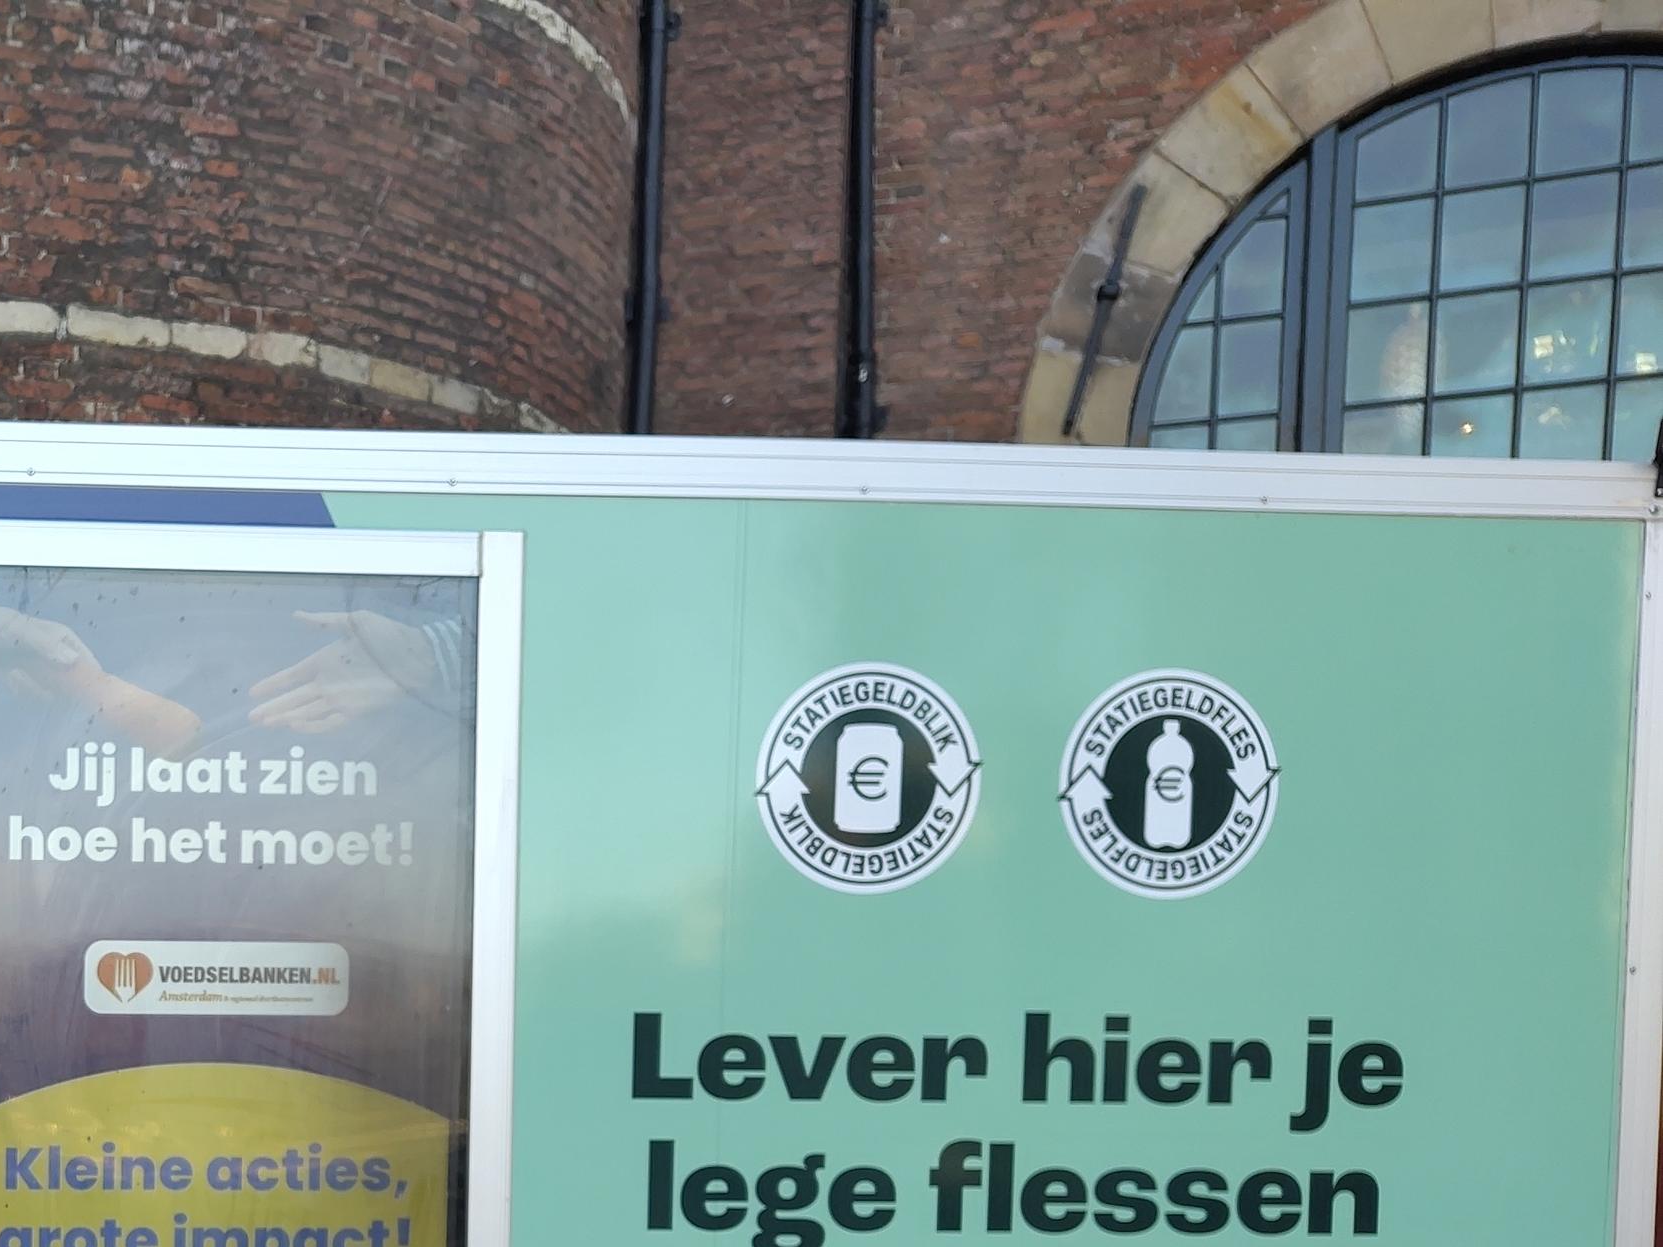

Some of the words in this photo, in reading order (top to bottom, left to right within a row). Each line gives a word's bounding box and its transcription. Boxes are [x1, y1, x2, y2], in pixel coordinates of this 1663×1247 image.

[784, 679, 959, 753] STATIEGELDBLIK
[1084, 686, 1256, 761] STATIEGELDFLES
[48, 741, 117, 807] Jij
[131, 747, 247, 795] laat
[258, 745, 378, 796] zien
[8, 815, 118, 862] hoe
[131, 816, 227, 863] het
[240, 821, 414, 867] moet!
[779, 805, 954, 876] STATIEGELDBLIK
[1082, 807, 1254, 881] STATIEGELDFLES
[158, 965, 340, 985] VOEDSELBANKEN.NL
[159, 989, 222, 1002] Amsterdam
[631, 1012, 989, 1103] Lever
[1021, 1012, 1274, 1105] hier
[1289, 1016, 1405, 1132] je
[4, 1141, 194, 1191] Kleine
[207, 1142, 408, 1200] acties,
[929, 1138, 1381, 1235] flessen
